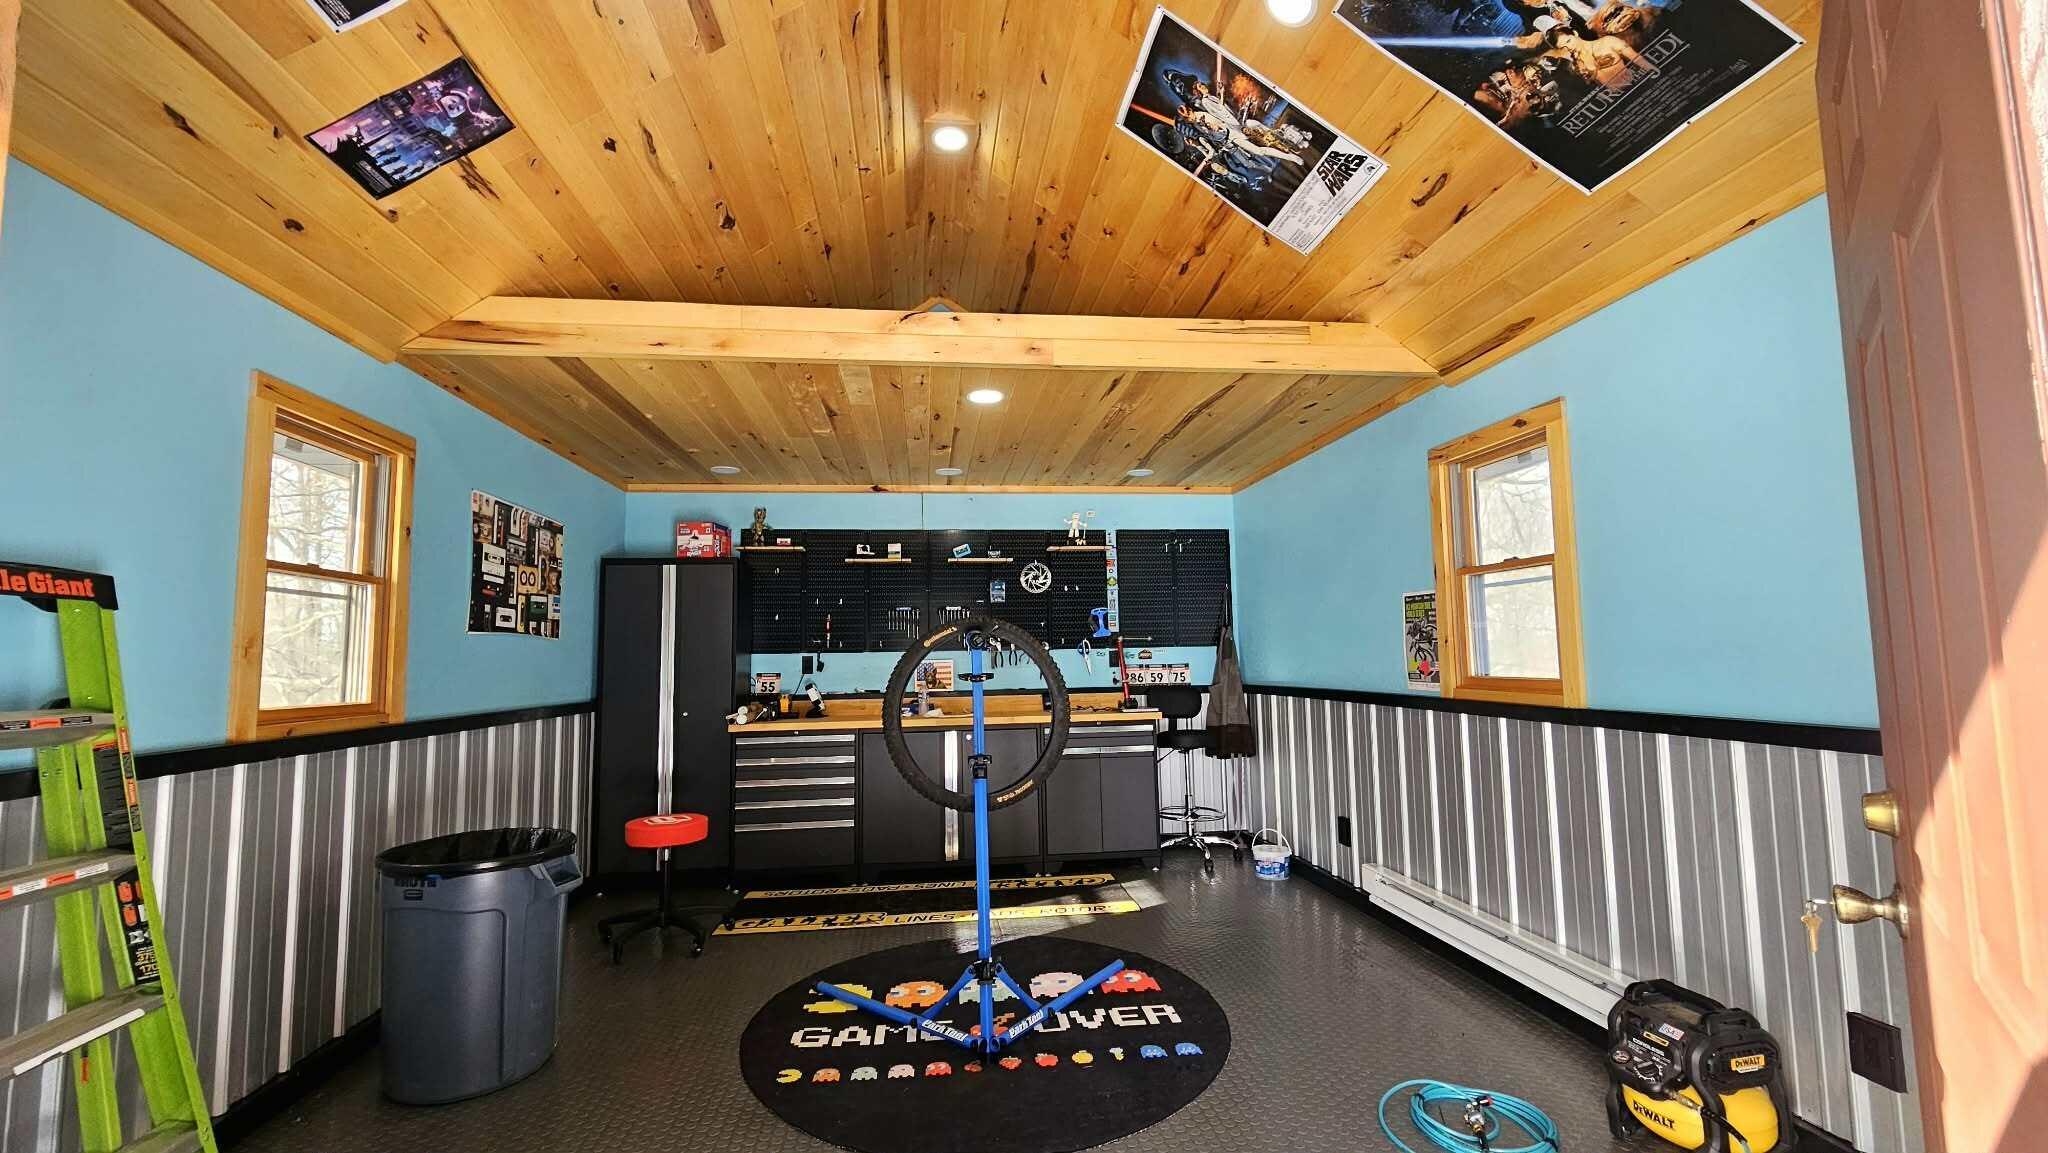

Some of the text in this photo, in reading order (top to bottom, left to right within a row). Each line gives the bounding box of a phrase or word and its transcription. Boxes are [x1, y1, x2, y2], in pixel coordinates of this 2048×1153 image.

[1316, 150, 1347, 181] STAR
[1324, 153, 1368, 197] WARS
[0, 568, 95, 597] le Giant
[1150, 672, 1163, 682] 59
[1173, 672, 1186, 682] 75
[761, 682, 776, 692] 55
[895, 913, 955, 923] LINES
